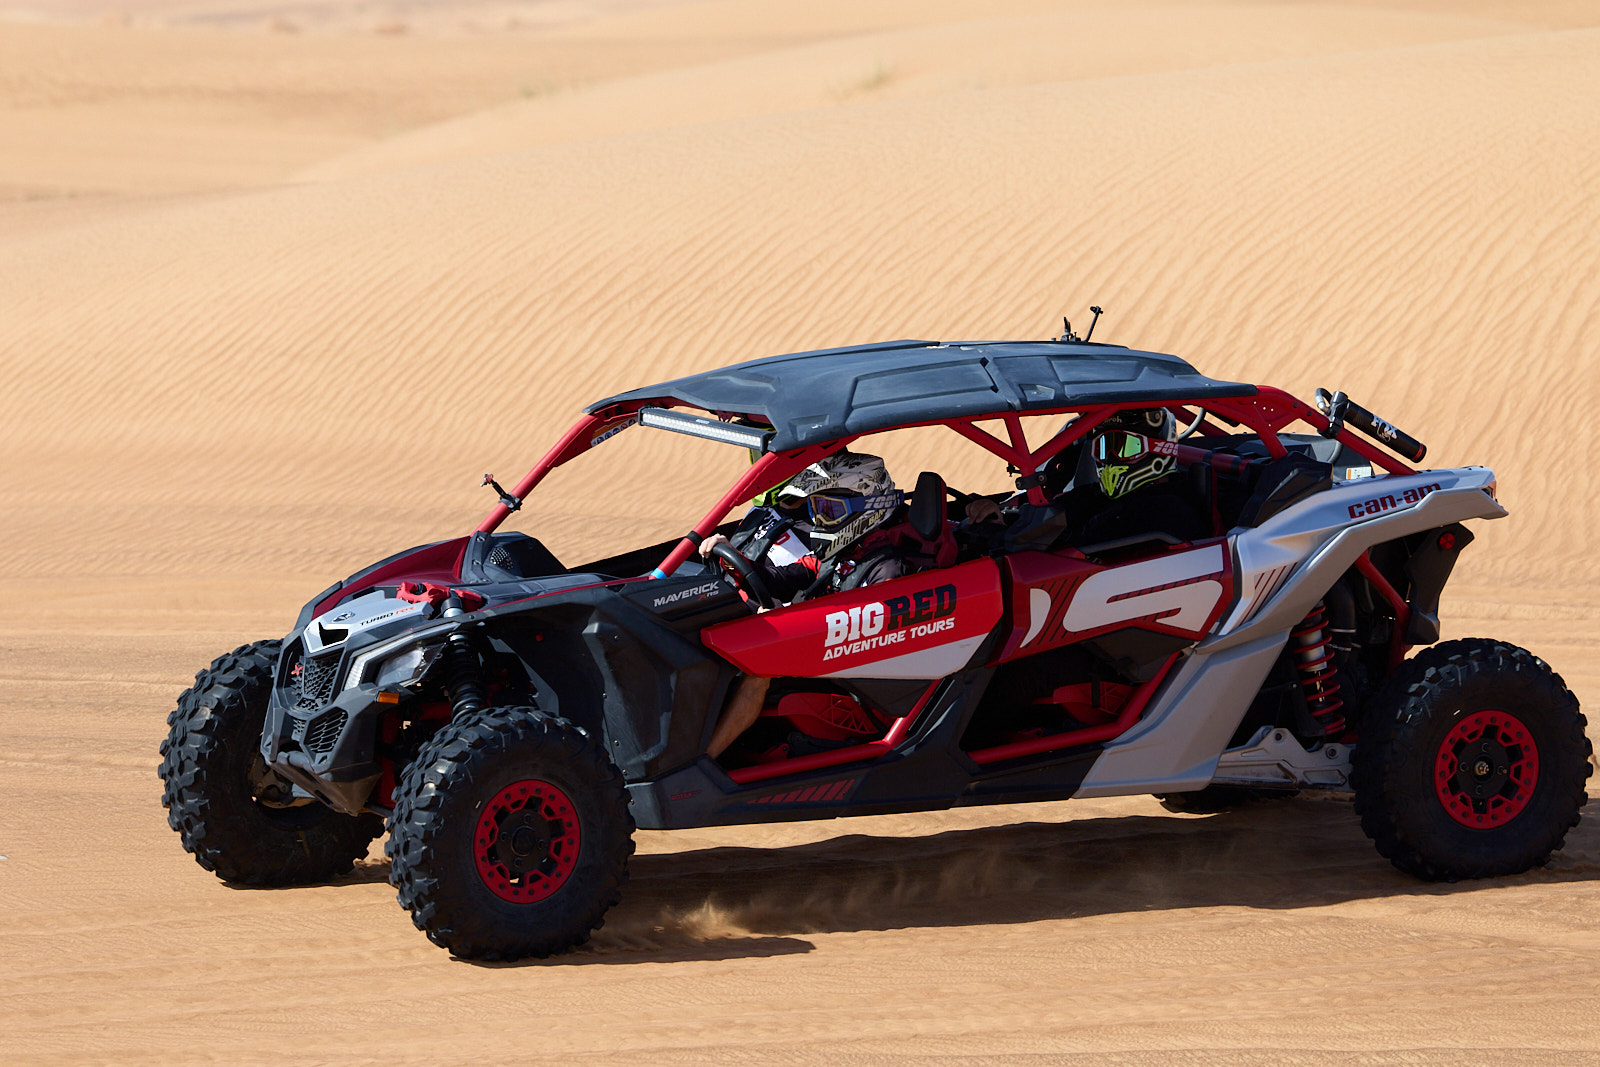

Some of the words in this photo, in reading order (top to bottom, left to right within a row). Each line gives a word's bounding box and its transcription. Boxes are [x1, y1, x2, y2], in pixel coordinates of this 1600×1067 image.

[1370, 414, 1398, 440] FOX
[1348, 482, 1442, 519] can-am
[653, 580, 720, 608] MAVERICK
[359, 612, 394, 626] TURBO
[824, 601, 885, 647] BIG
[885, 583, 957, 631] RED
[822, 629, 906, 662] ADVENTURE
[910, 617, 955, 639] TOURS
